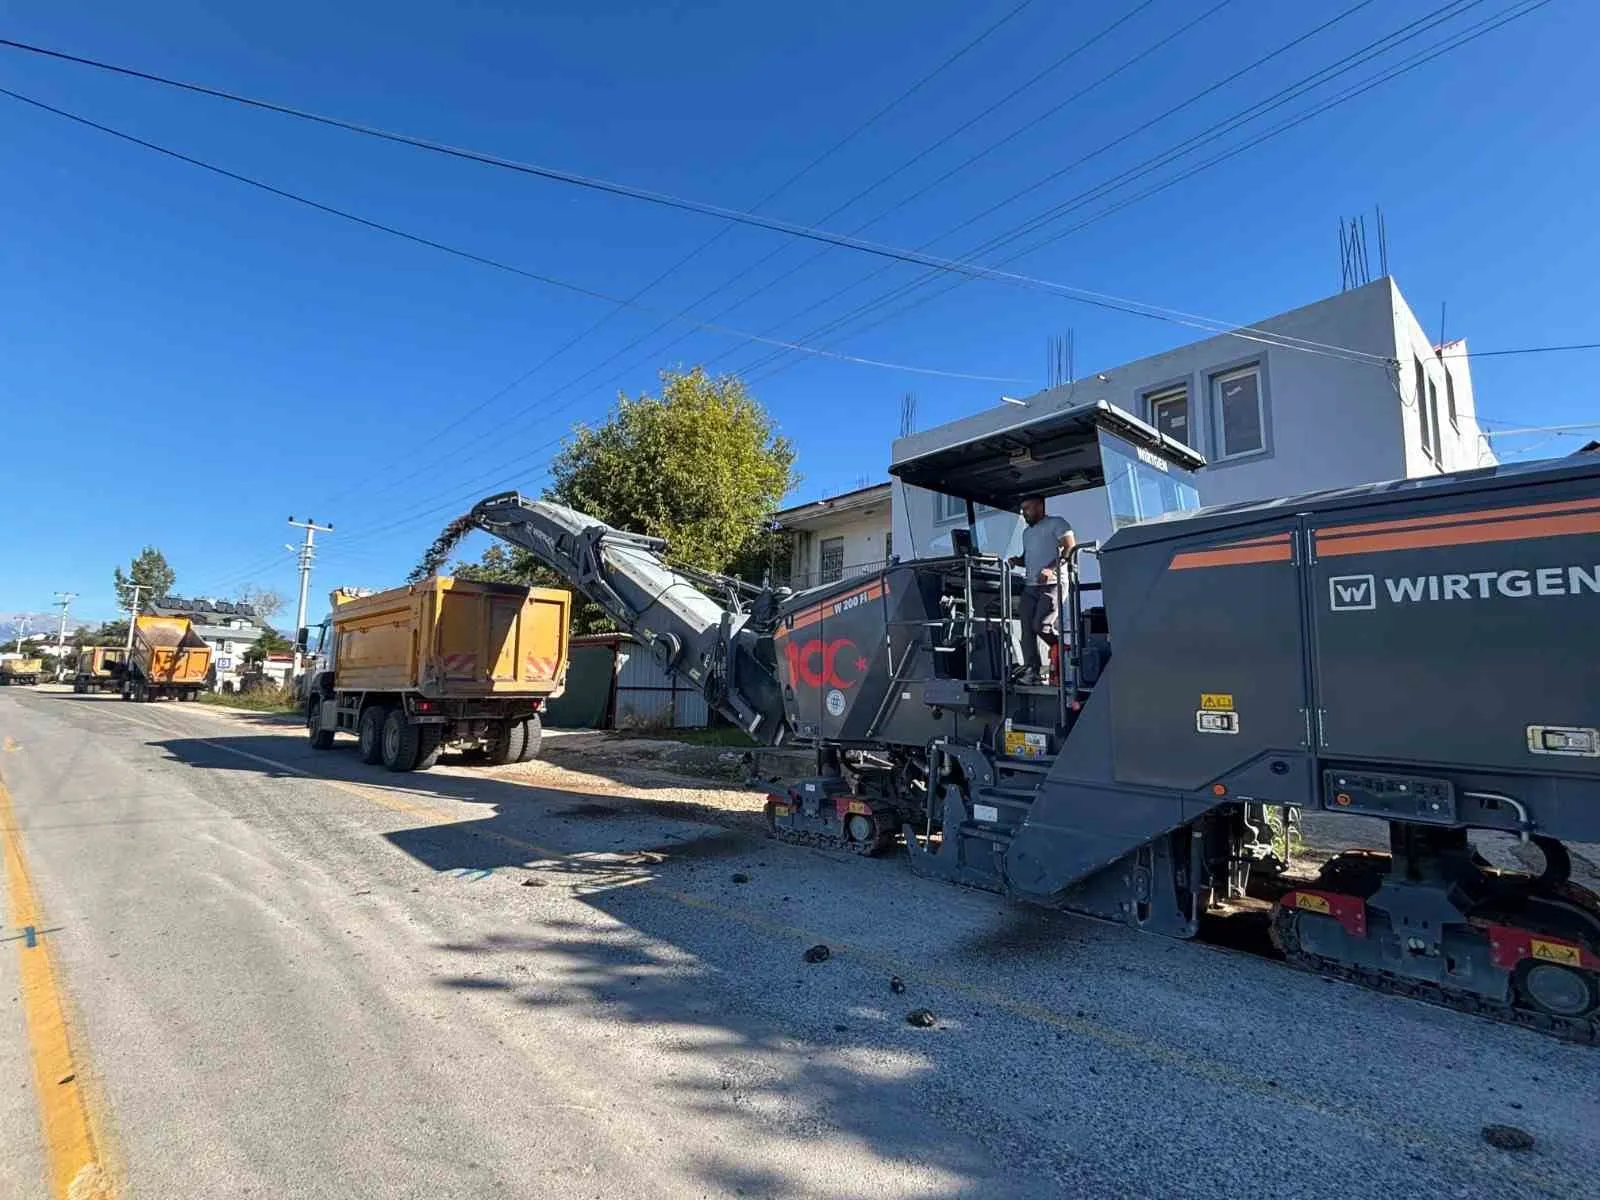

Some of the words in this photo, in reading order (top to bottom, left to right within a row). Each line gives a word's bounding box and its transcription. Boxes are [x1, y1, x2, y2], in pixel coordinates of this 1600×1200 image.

[1333, 580, 1370, 604] W
[1384, 565, 1600, 602] WIRTGEN
[843, 596, 859, 610] 200
